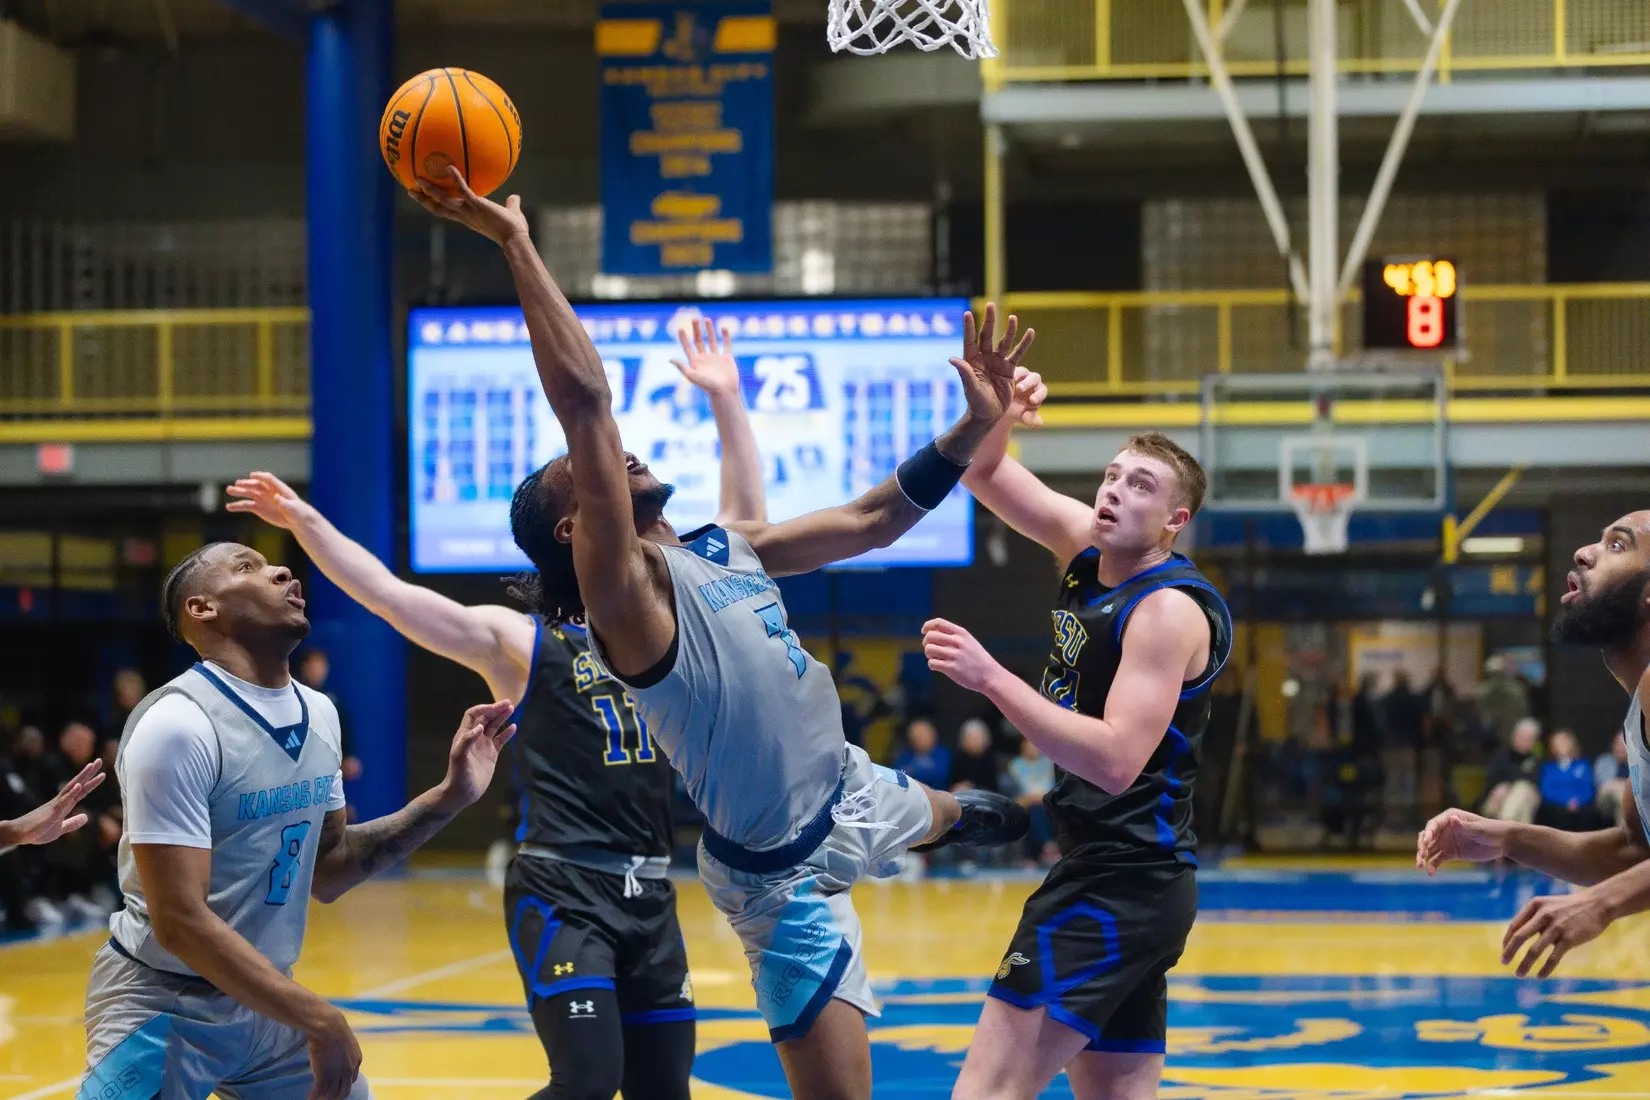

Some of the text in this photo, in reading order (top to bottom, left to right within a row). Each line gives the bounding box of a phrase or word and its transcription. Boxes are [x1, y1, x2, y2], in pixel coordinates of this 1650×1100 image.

[1407, 296, 1445, 349] 8
[753, 355, 811, 410] 25
[591, 692, 657, 767] 11
[238, 780, 311, 820] KANSAS
[265, 820, 312, 906] 8
